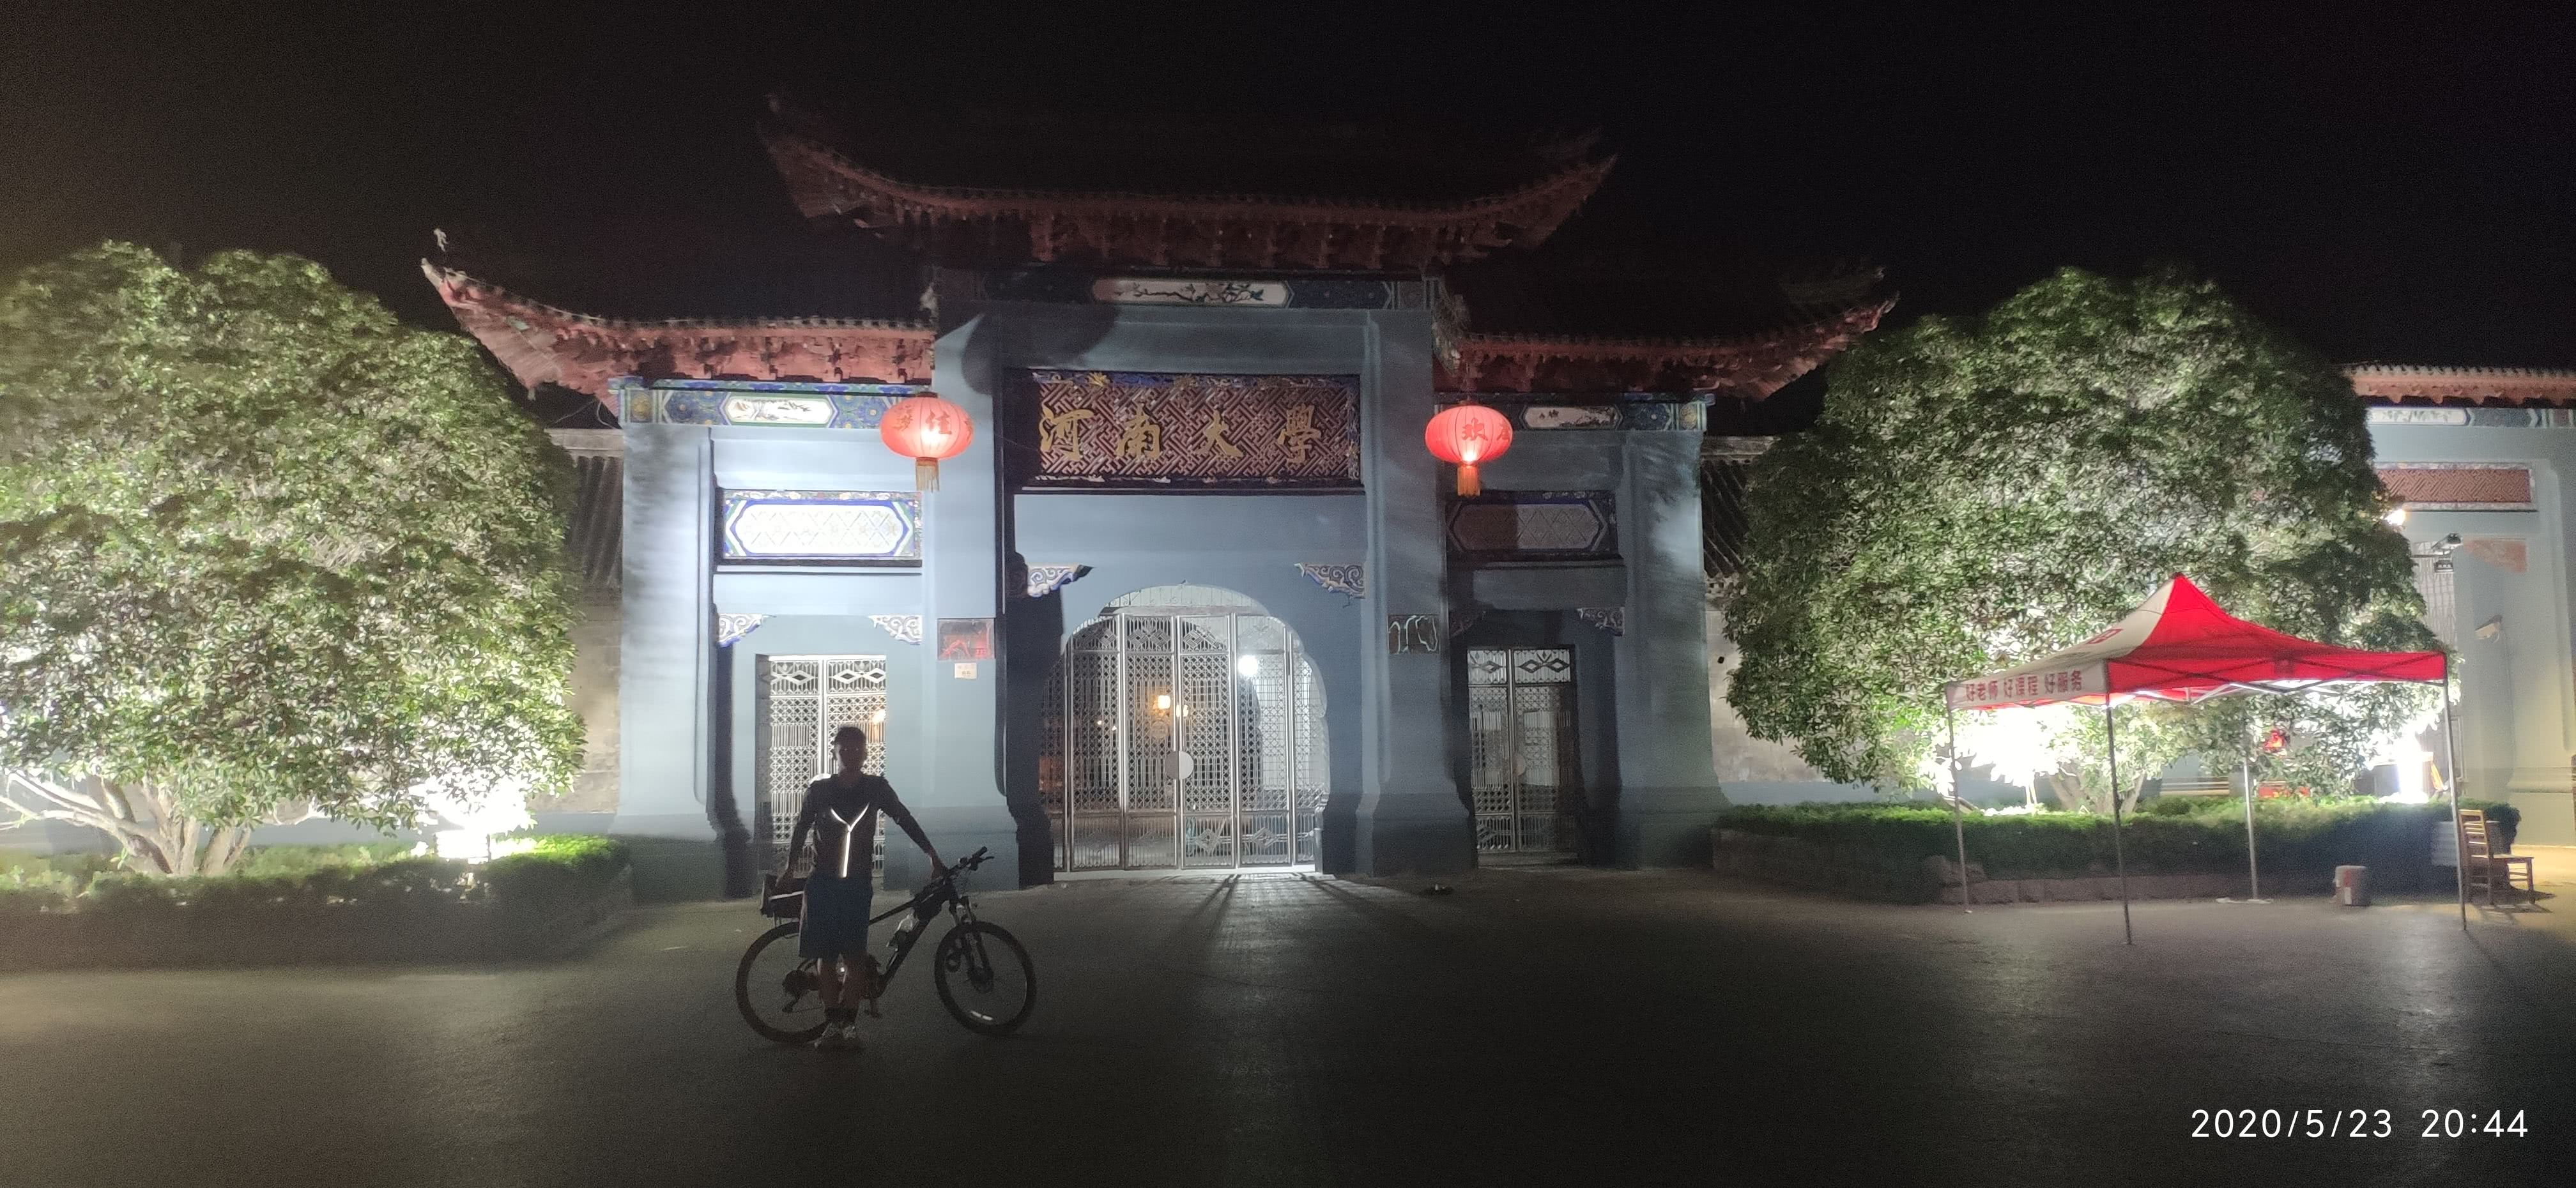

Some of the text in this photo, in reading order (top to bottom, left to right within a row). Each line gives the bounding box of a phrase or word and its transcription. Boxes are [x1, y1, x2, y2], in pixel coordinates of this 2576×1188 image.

[1039, 401, 1322, 464] 河南大學
[1966, 680, 1998, 701] 好老师
[2044, 669, 2083, 694] 好服务
